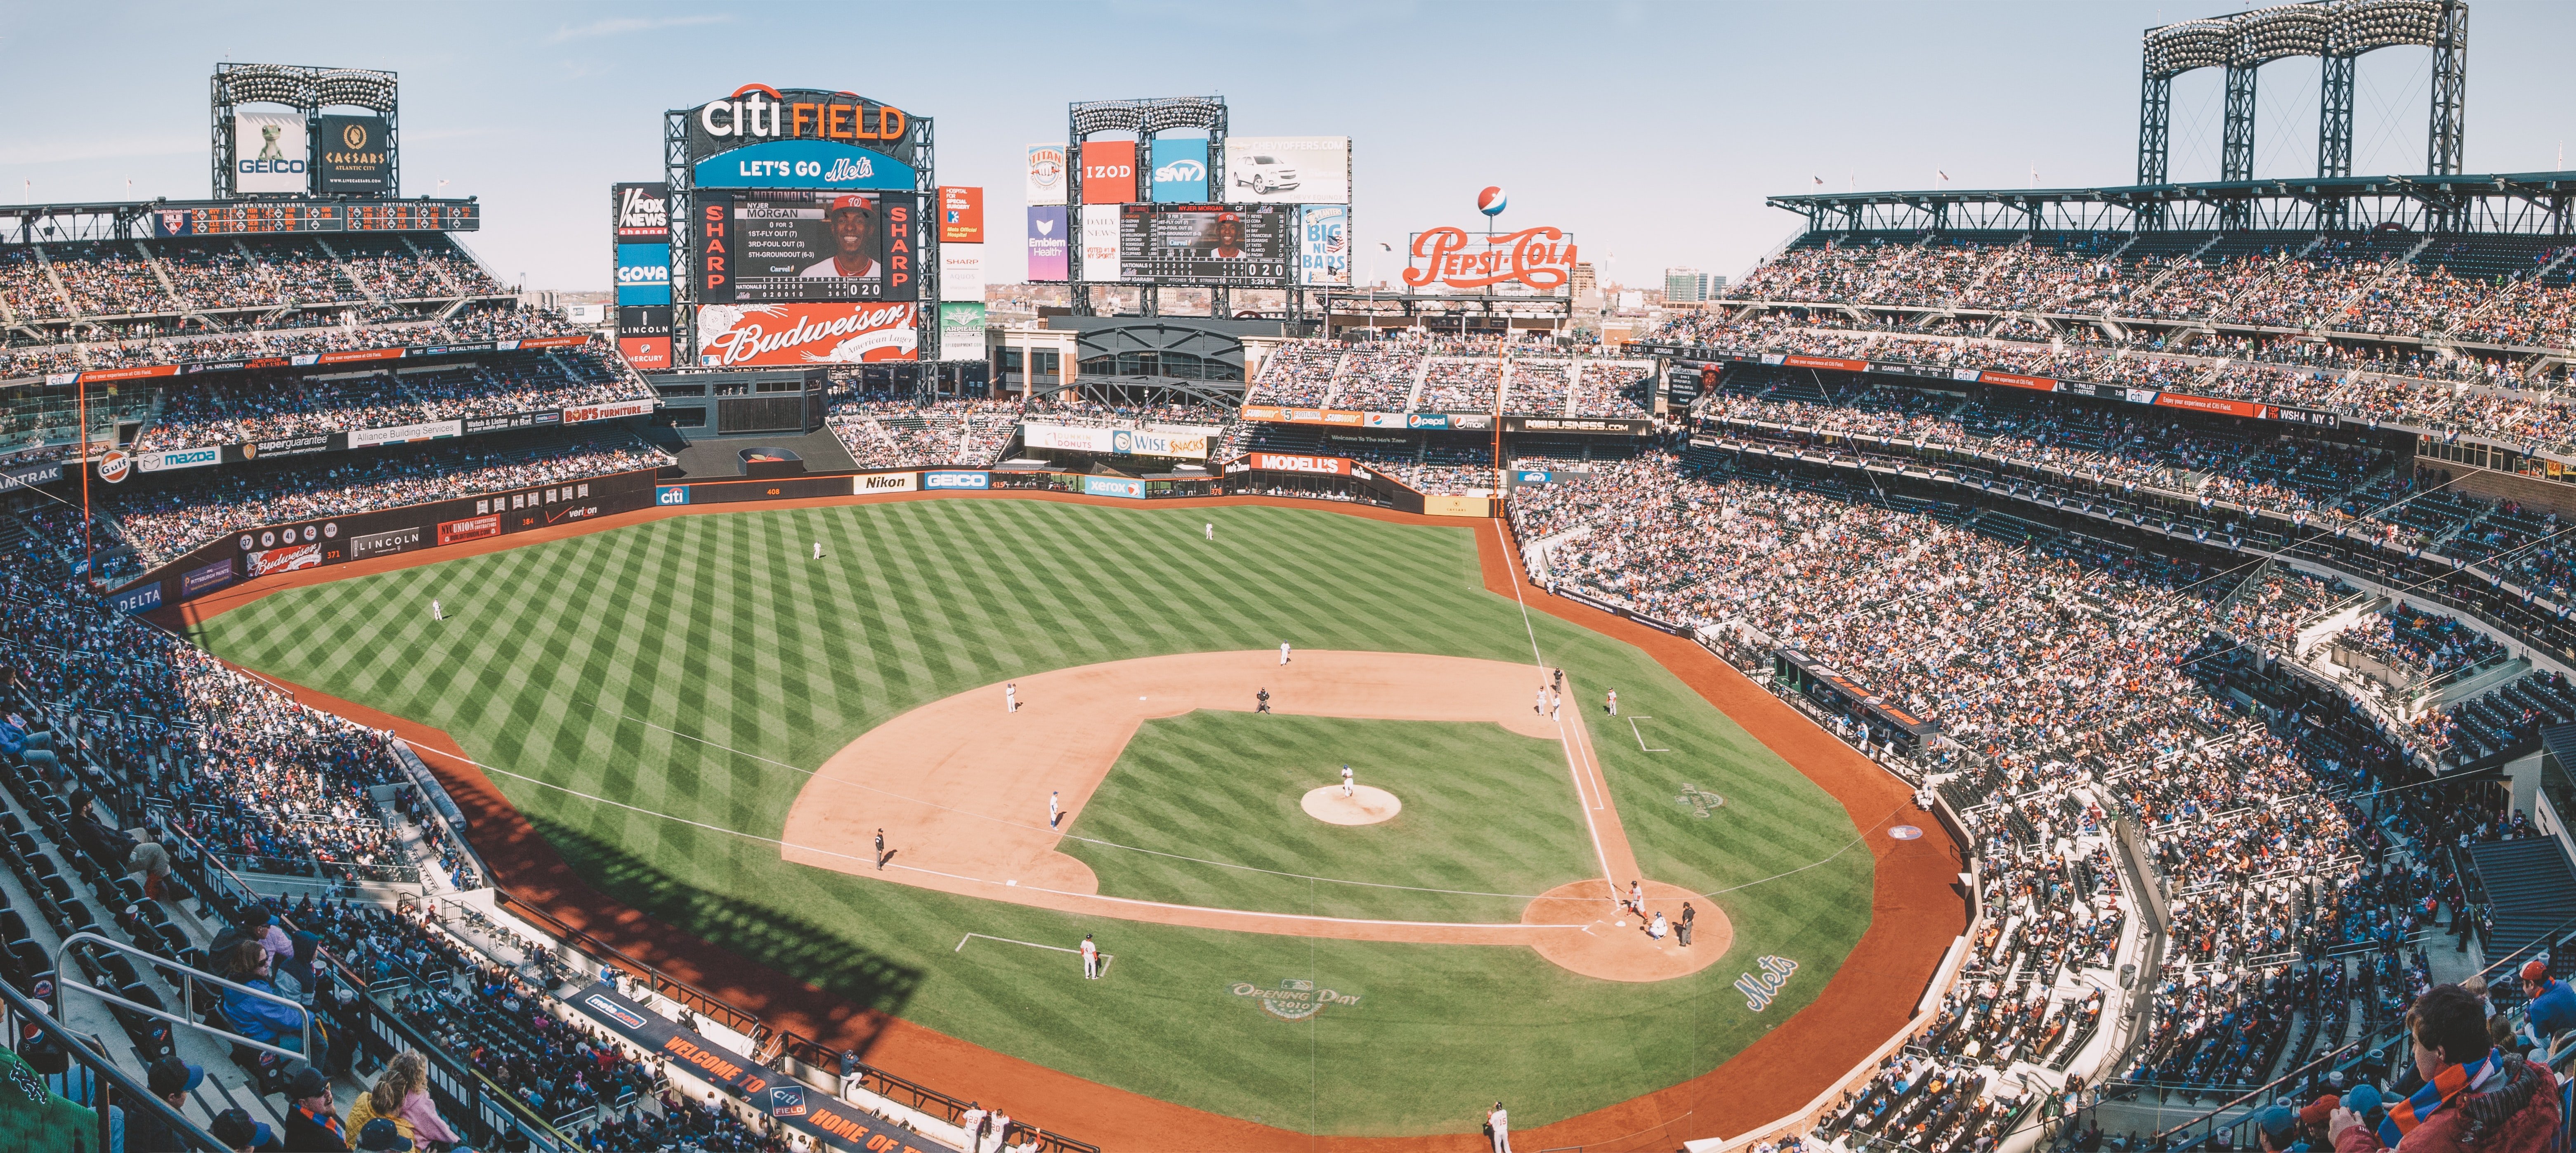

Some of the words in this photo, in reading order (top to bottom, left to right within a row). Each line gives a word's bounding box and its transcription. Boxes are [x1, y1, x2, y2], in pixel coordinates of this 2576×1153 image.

[702, 92, 780, 137] citi
[793, 103, 905, 140] FIELD
[1254, 141, 1343, 151] CHEVYOFFERS.COM
[326, 152, 385, 164] CAESARS
[1032, 151, 1061, 164] TITAN
[239, 160, 305, 173] GEICO
[740, 161, 790, 176] LET'S
[795, 161, 821, 176] GO
[824, 156, 874, 182] Mets
[1086, 165, 1131, 178] IZOD
[634, 198, 666, 213] FOX
[626, 213, 667, 227] NEWS
[747, 209, 798, 218] MORGAN
[1307, 224, 1341, 241] BIG
[706, 206, 725, 289] SHARP
[891, 207, 908, 287] SHARP
[1029, 238, 1065, 247] Emblem
[1034, 247, 1062, 256] Health
[1303, 255, 1345, 269] BARS
[619, 266, 668, 283] GOYA
[622, 326, 668, 334] LINCOLN
[711, 304, 905, 366] Budweiser
[847, 335, 887, 355] American
[889, 331, 914, 344] Lager
[2131, 393, 2142, 402] citi
[2184, 399, 2206, 408] experience
[565, 407, 598, 422] BOB'S
[600, 406, 641, 418] FURNITURE
[1244, 409, 1279, 418] SUBWAY
[1281, 409, 1292, 421] $5
[1325, 413, 1361, 423] SUBWAY
[1421, 417, 1445, 426] pepsi
[2281, 409, 2300, 421] WSH
[2301, 413, 2305, 422] 4
[2312, 414, 2324, 424] NY
[520, 418, 531, 426] Bat
[357, 432, 387, 442] Alliance
[390, 428, 420, 439] Building
[423, 425, 454, 436] Services
[258, 436, 327, 451] superguarantee
[1058, 440, 1091, 449] DONUTS
[1134, 435, 1166, 451] WISE
[1169, 438, 1204, 454] SNACKS
[101, 458, 126, 474] Gulf
[1261, 455, 1338, 474] MODELL'S
[866, 477, 905, 489] Nikon
[927, 474, 986, 487] GEICO
[1091, 480, 1125, 493] xerox
[661, 487, 683, 504] citi
[569, 506, 597, 518] verizon
[475, 522, 497, 530] CONTRACTORS
[360, 534, 419, 551] LINCOLN
[450, 529, 490, 541] BUILDITUNION.COM
[257, 543, 316, 575] Budweiser
[327, 551, 340, 559] 371
[191, 574, 215, 584] PITTSBURGH
[216, 569, 229, 577] PAINTS
[120, 589, 161, 612] DELTA
[1734, 955, 1799, 1013] Mets
[1232, 983, 1311, 1001] OPENING
[1314, 989, 1360, 1006] DAY
[591, 997, 639, 1026] mets.com
[1278, 1001, 1310, 1009] 2010
[664, 1035, 743, 1081] WELCOME
[739, 1074, 766, 1093] TO
[773, 1090, 801, 1106] citi
[776, 1106, 803, 1115] FIELD
[808, 1108, 869, 1144] HOME
[867, 1134, 900, 1153] OF
[992, 1124, 1000, 1132] 20
